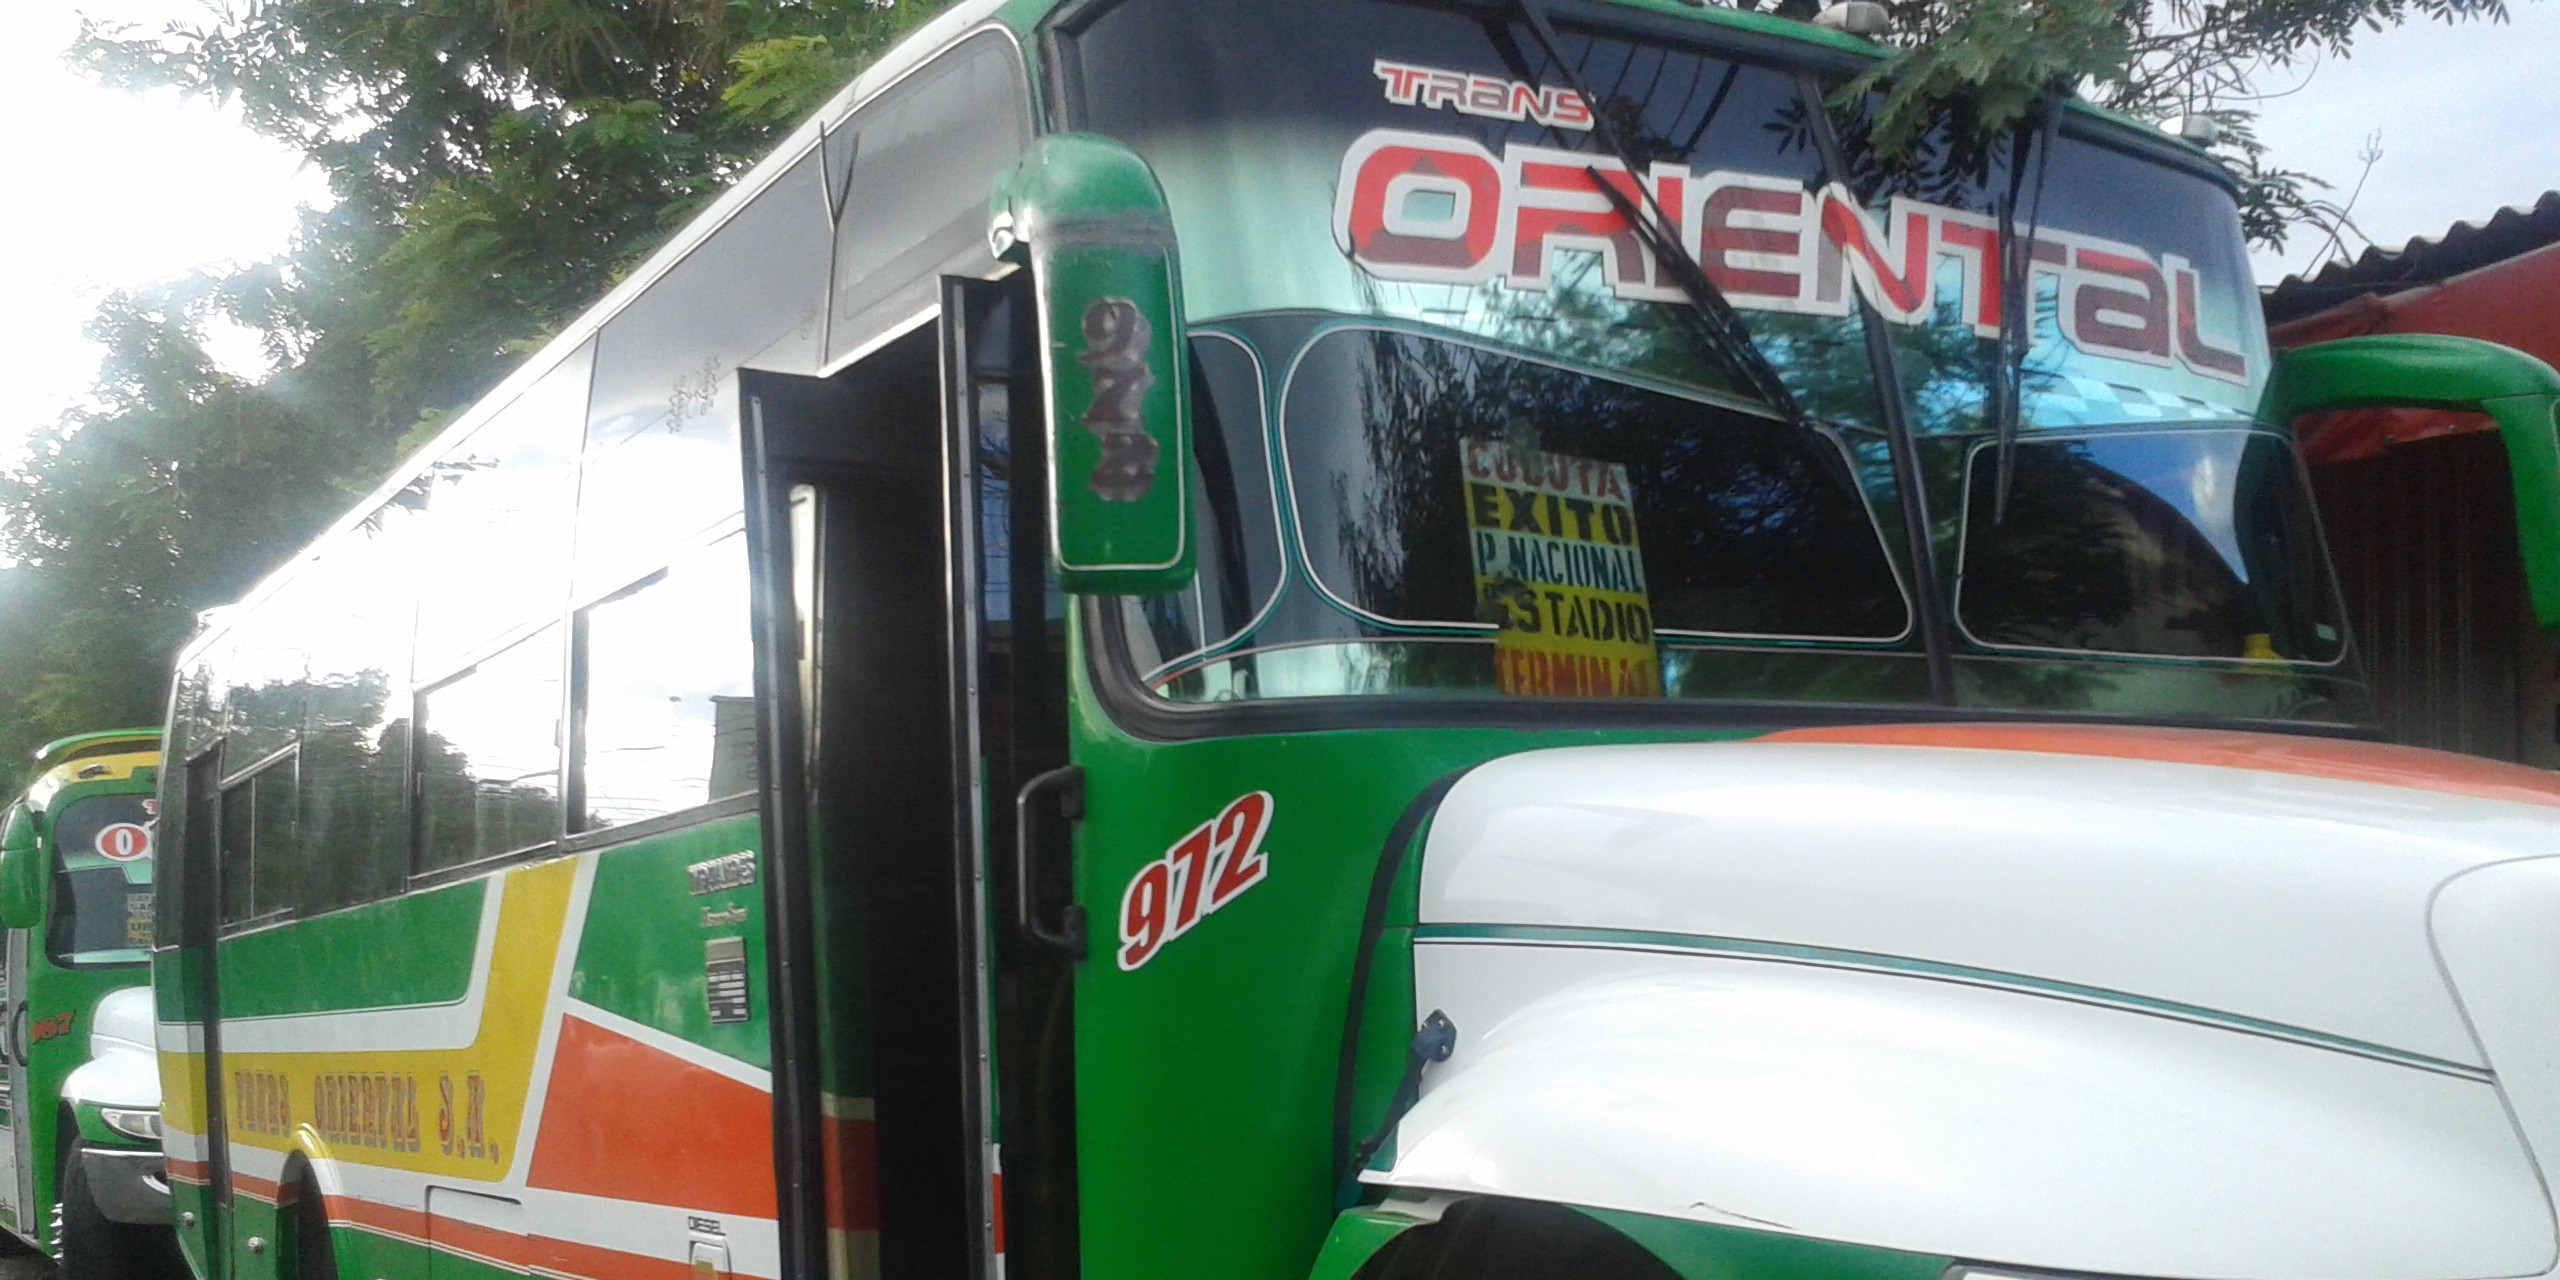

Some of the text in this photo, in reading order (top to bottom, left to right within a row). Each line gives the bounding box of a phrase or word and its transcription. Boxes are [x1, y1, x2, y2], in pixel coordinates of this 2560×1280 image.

[1470, 483, 1634, 547] EXITO
[1507, 536, 1646, 594] NACIONAL
[1117, 789, 1274, 972] 972
